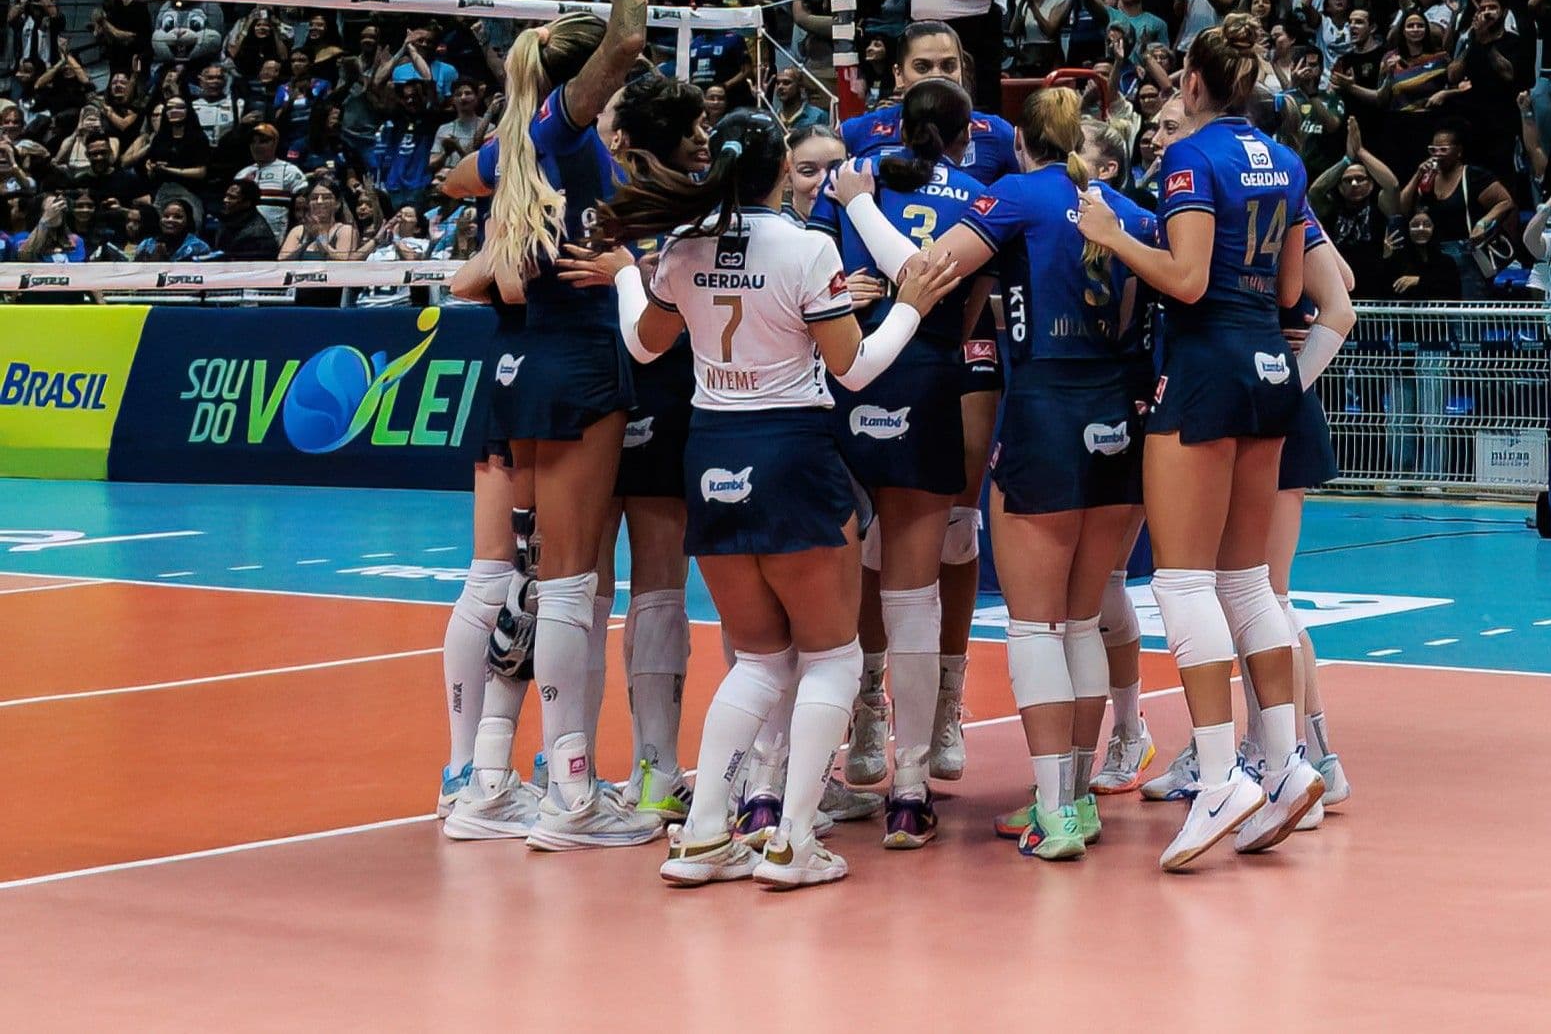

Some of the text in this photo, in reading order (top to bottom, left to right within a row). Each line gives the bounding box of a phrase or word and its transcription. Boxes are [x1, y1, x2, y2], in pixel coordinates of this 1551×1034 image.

[1240, 170, 1290, 187] GERDAU
[903, 204, 938, 250] 3
[1243, 199, 1287, 267] 14
[693, 272, 766, 290] GERDAU
[713, 295, 743, 364] 7
[1009, 285, 1027, 343] KTO
[1, 361, 109, 411] BRASIL
[180, 358, 249, 400] SOU
[706, 367, 761, 391] NYEME
[188, 402, 237, 444] DO
